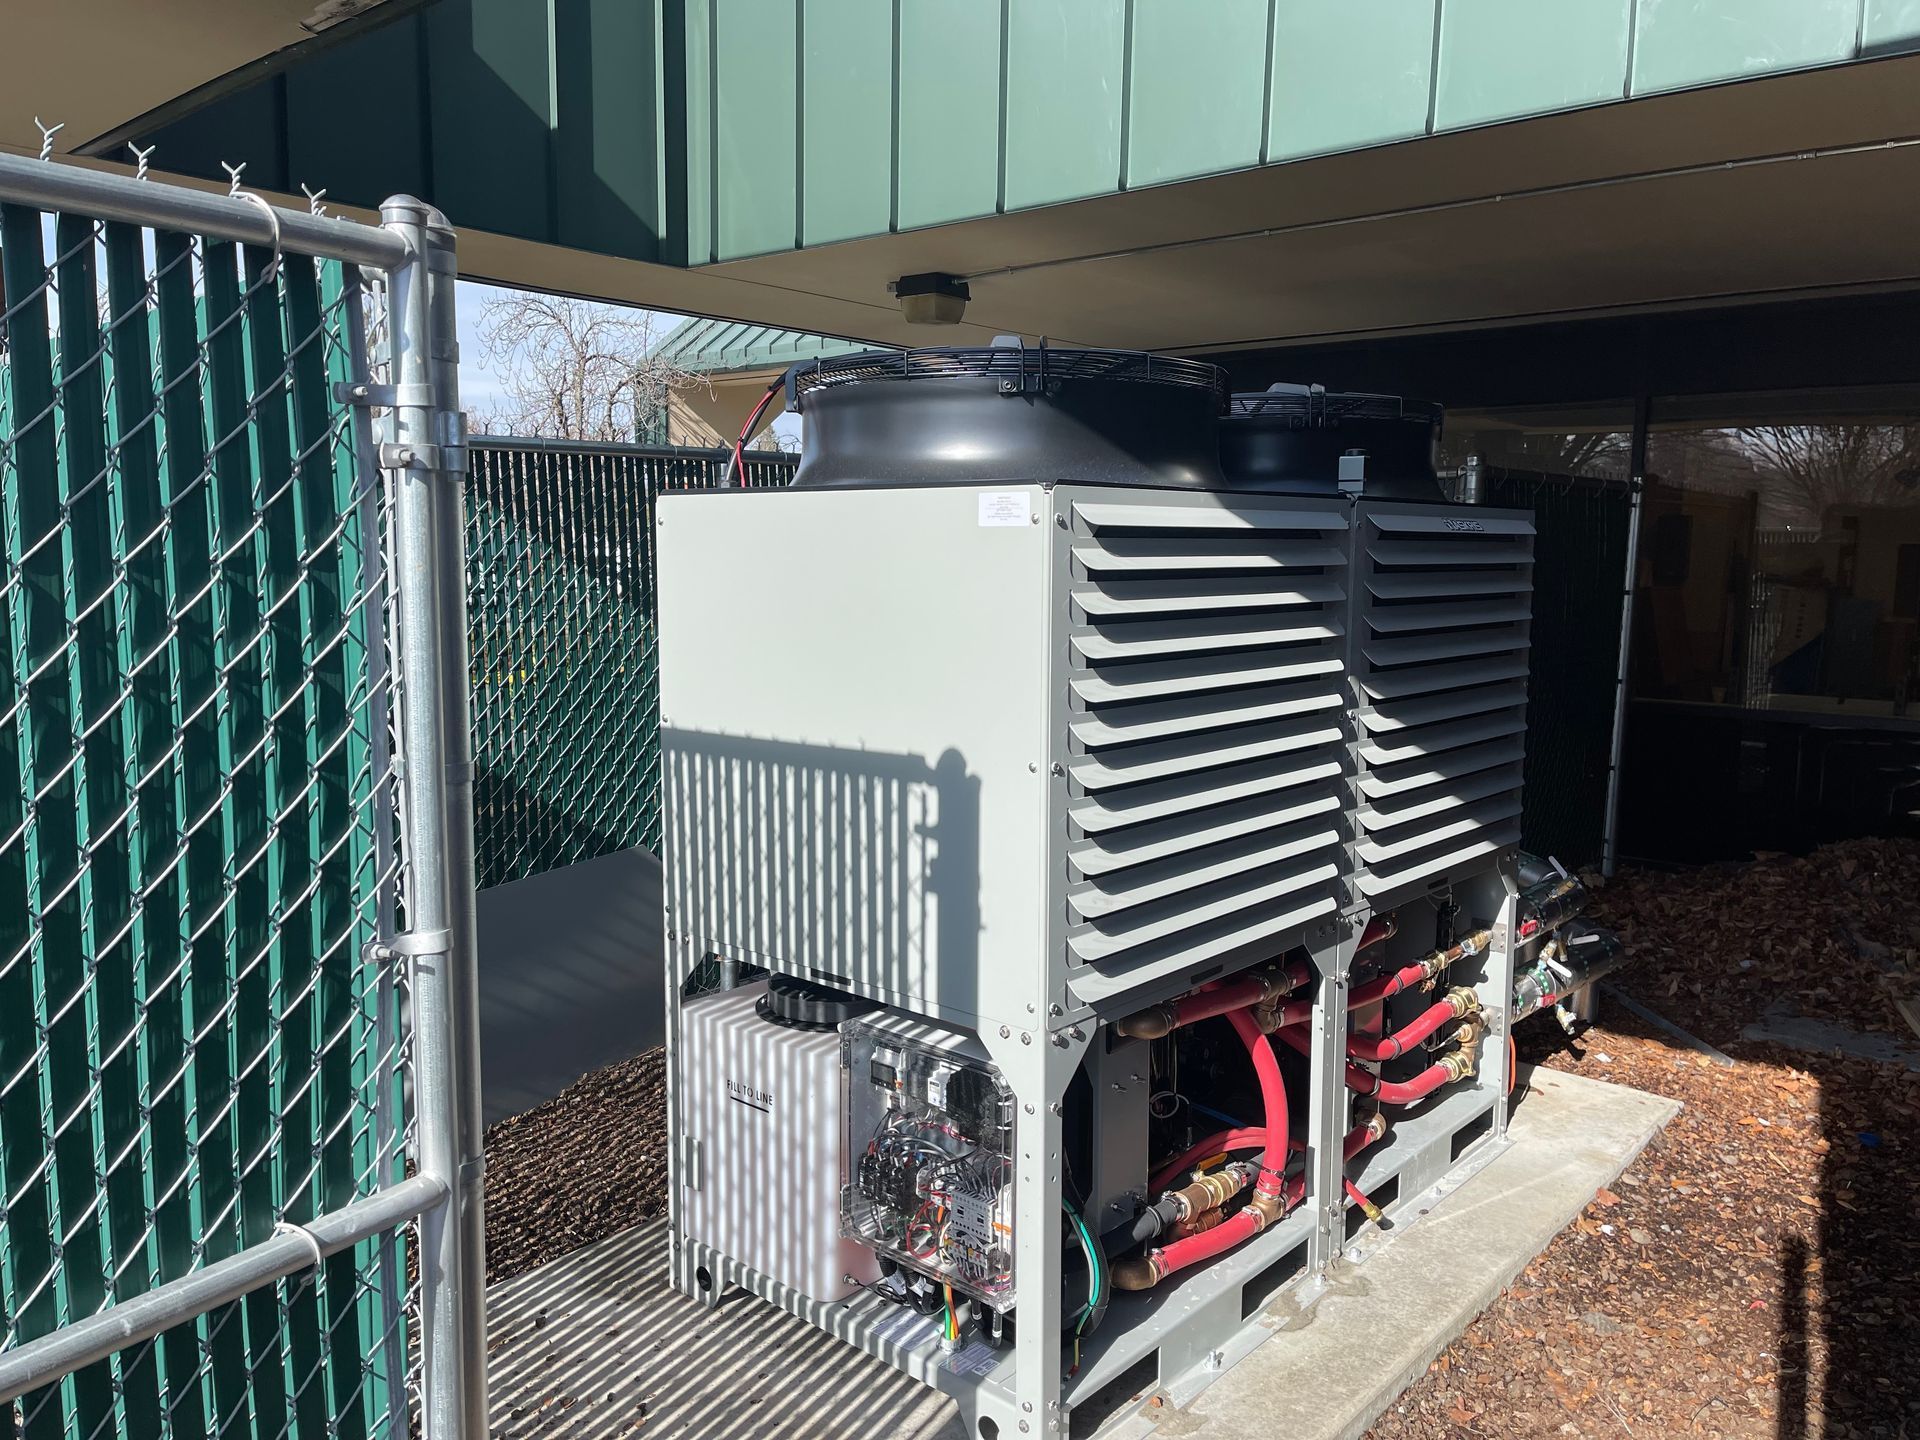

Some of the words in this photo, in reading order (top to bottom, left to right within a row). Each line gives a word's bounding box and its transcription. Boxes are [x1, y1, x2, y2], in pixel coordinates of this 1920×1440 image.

[726, 1079, 741, 1093] FILL
[743, 1085, 754, 1098] TO
[756, 1090, 773, 1106] LINE
